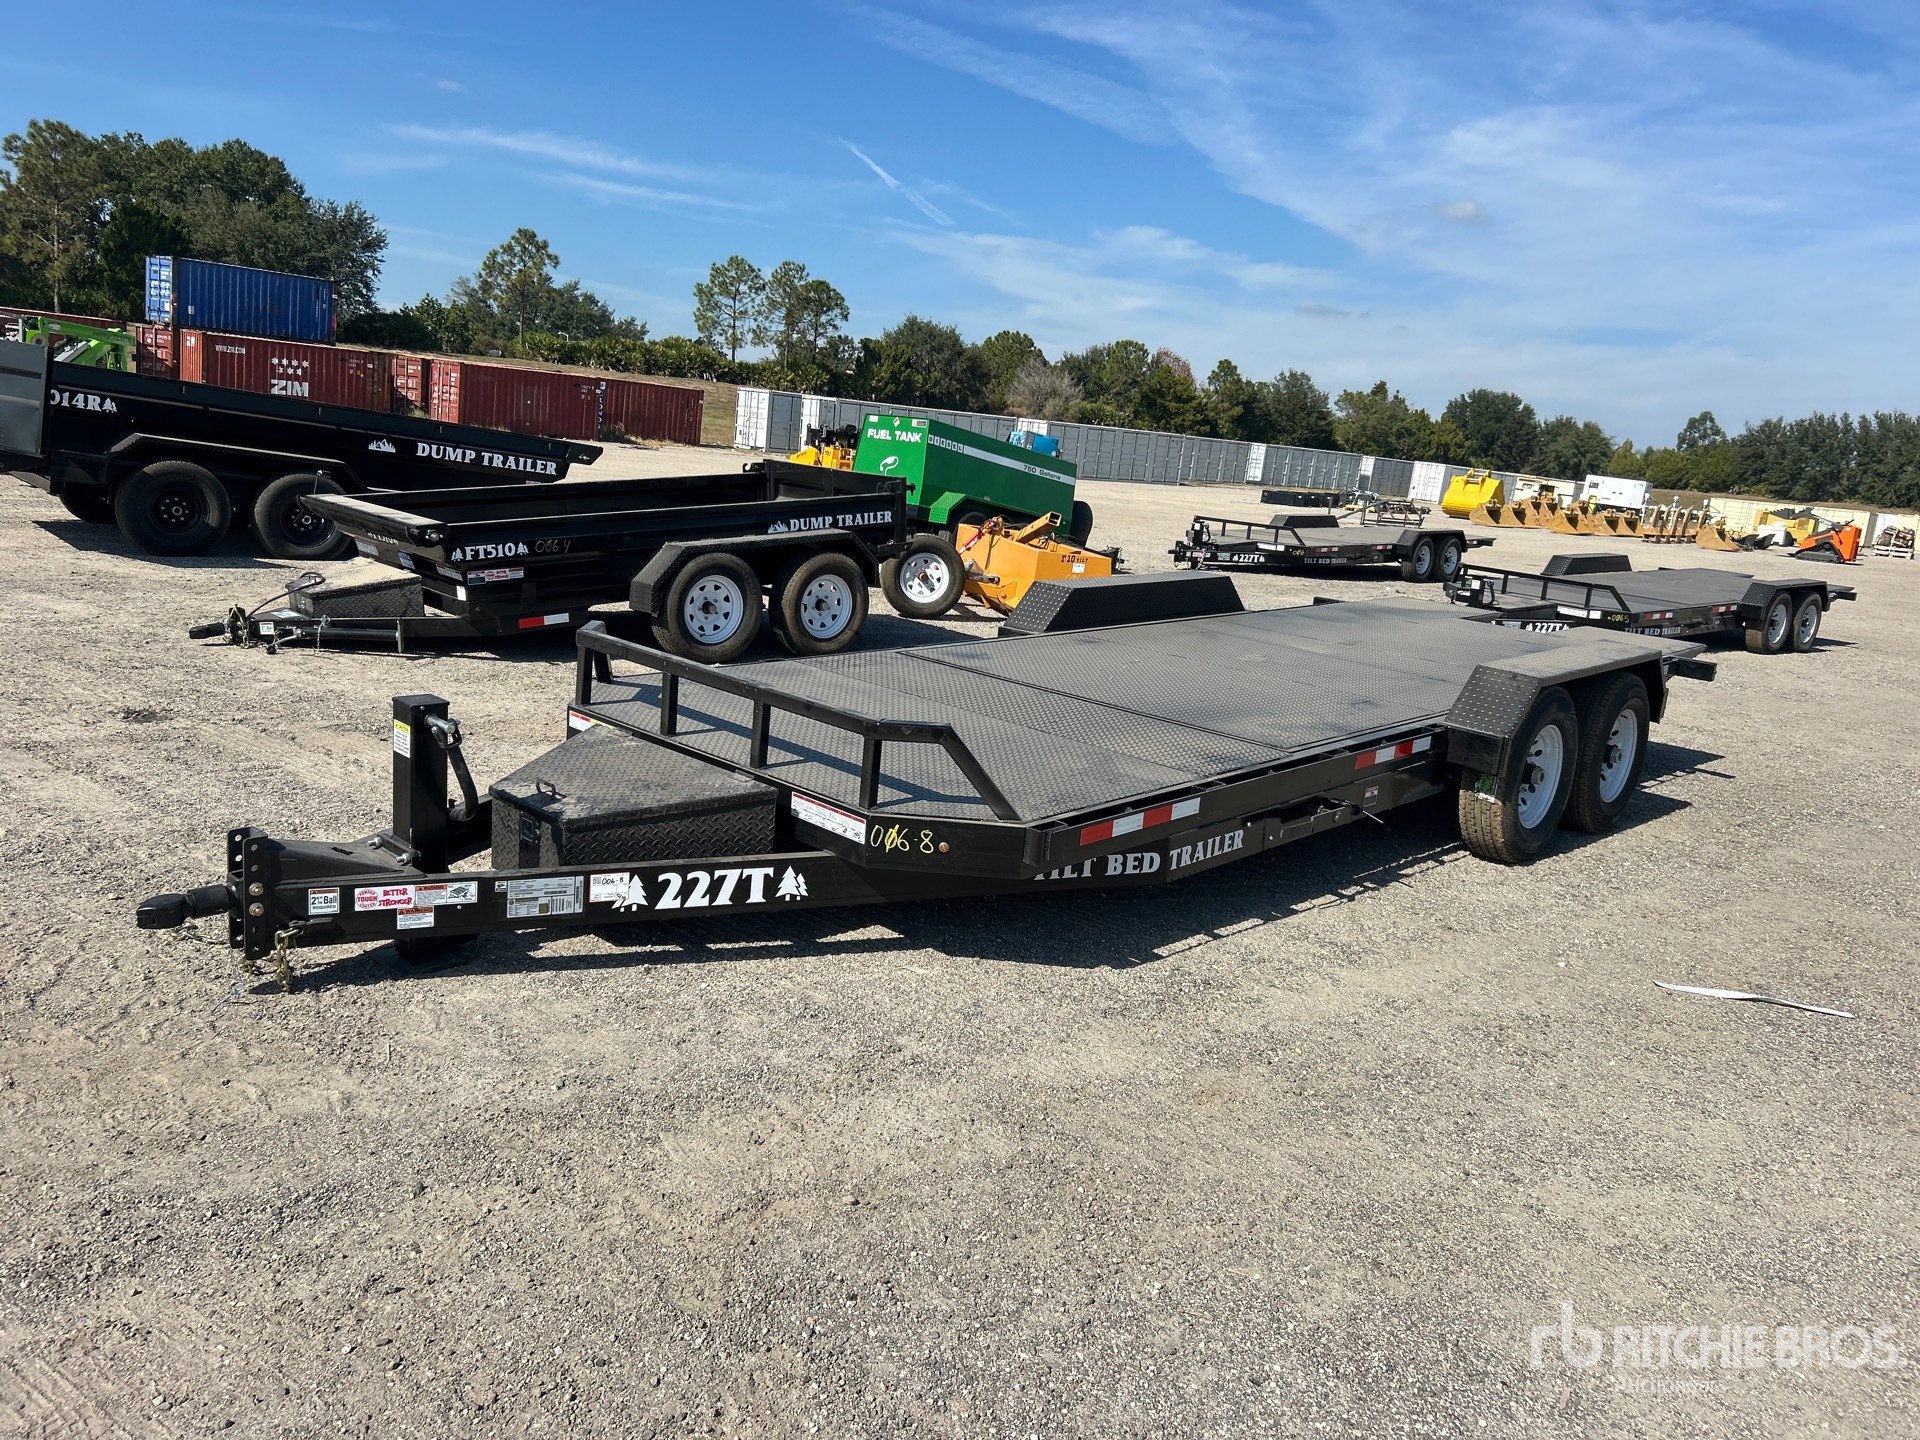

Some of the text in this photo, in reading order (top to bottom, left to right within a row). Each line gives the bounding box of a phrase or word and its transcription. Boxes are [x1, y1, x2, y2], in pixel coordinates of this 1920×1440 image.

[271, 379, 309, 397] ZIM
[867, 428, 922, 443] FUEL TANK
[416, 442, 557, 475] DUMP TRAILER
[1023, 464, 1037, 474] 750
[789, 510, 893, 532] DUMP TRAILER
[464, 542, 516, 560] FT510
[1239, 554, 1260, 563] 227T
[1535, 622, 1563, 634] 227T
[1105, 852, 1161, 876] BED
[1169, 829, 1244, 871] TRAILER
[383, 888, 408, 896] BETTER
[654, 867, 775, 910] 227T
[323, 895, 337, 904] Ball
[378, 897, 412, 907] STRONGER
